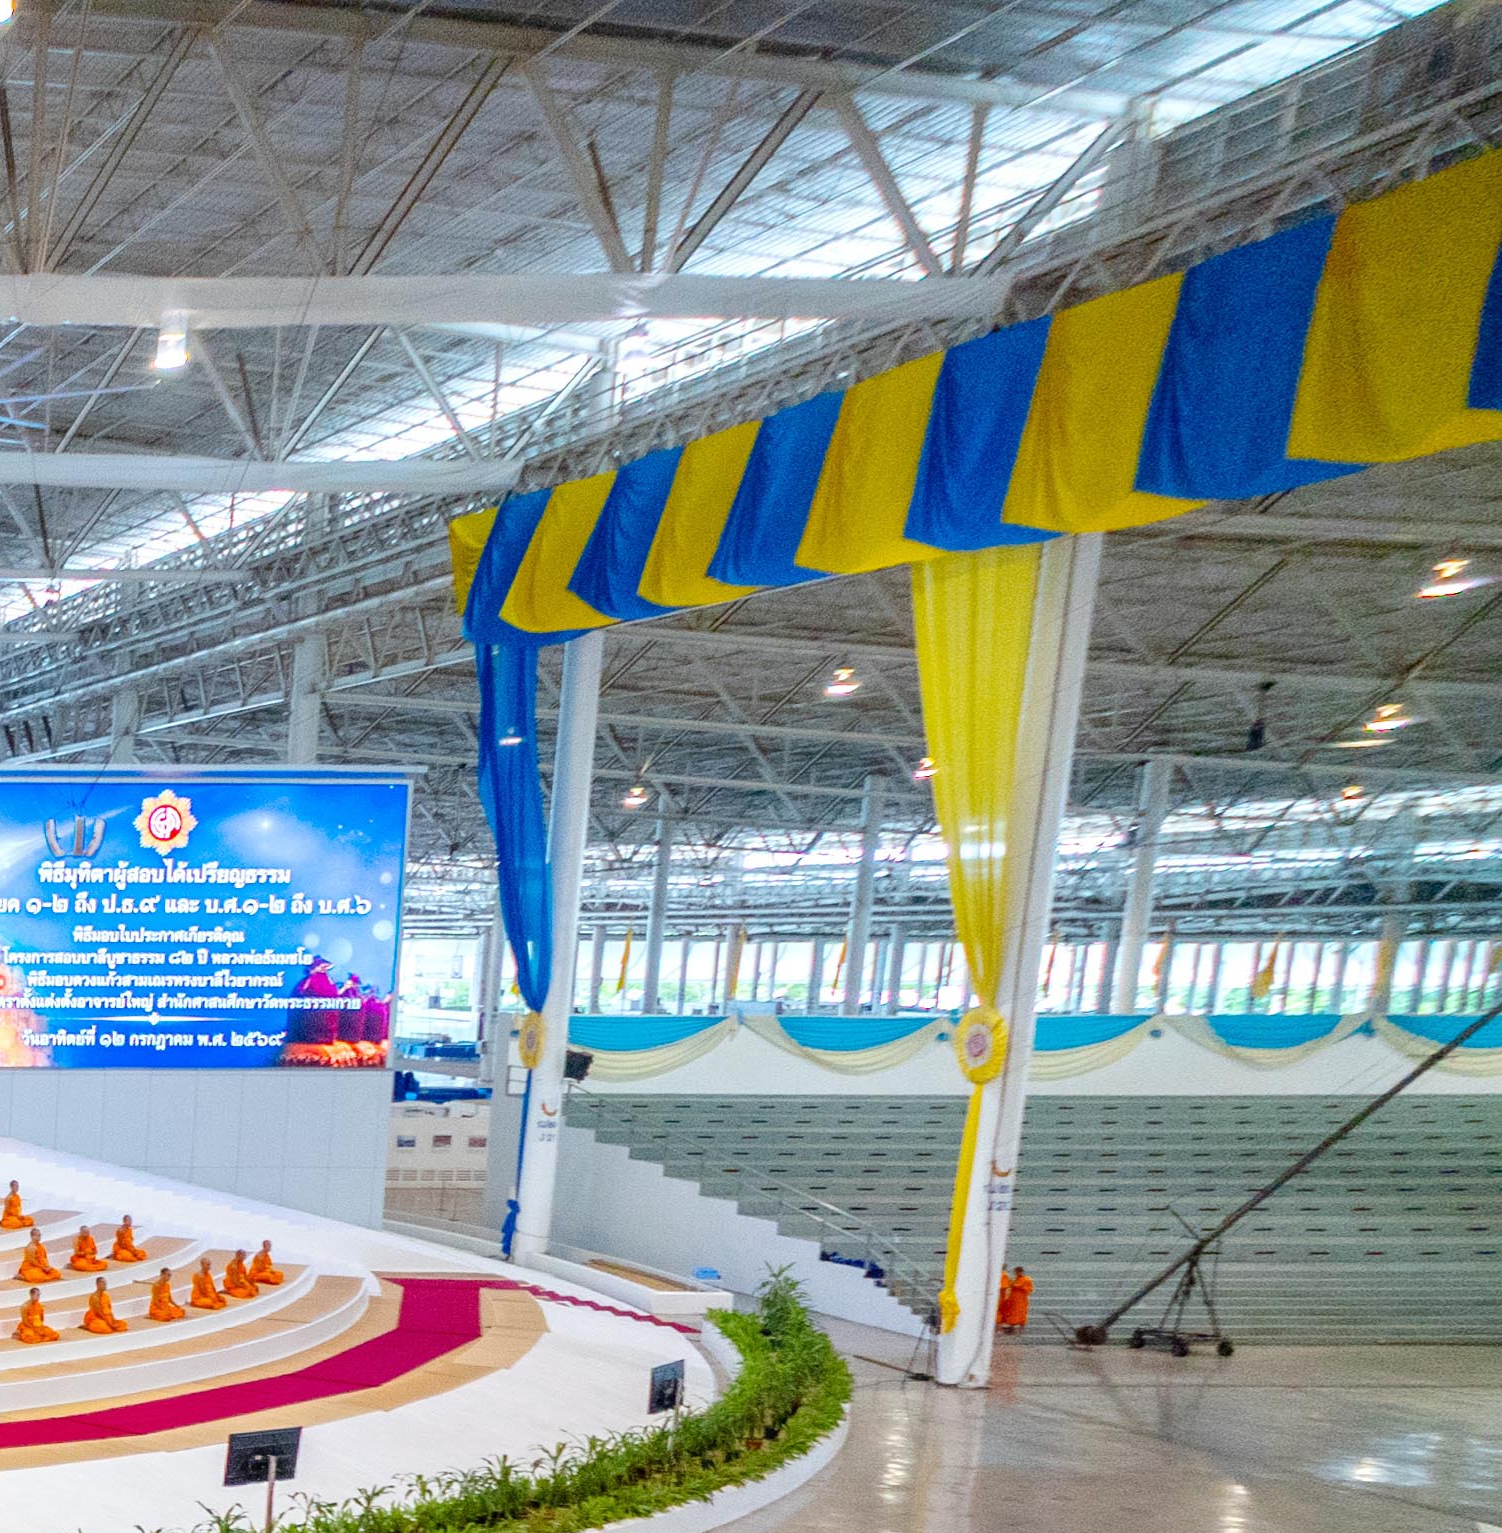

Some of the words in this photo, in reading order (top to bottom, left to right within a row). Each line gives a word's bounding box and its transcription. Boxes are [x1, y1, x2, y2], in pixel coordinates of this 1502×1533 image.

[38, 858, 291, 890] พิธีมุทิตาผู้สอบได้เปรียญธรรม
[25, 894, 69, 914] ๑-๒
[74, 891, 96, 913] ถึง
[101, 893, 161, 913] ป.ธ.๙
[164, 898, 200, 914] และ
[290, 892, 313, 914] ถึง
[318, 895, 372, 914] บ.ศ.๖
[72, 924, 246, 948] พิธีมอบใบประกาศเกียรติคุณ
[196, 948, 209, 964] ปี
[21, 1025, 96, 1046] วันอาทิตย์ที่
[99, 1030, 125, 1048] ๑๒
[129, 1032, 194, 1050] กรกฎาคม
[197, 1032, 227, 1046] พ.ศ.
[230, 1030, 287, 1047] ๒๕๖๙
